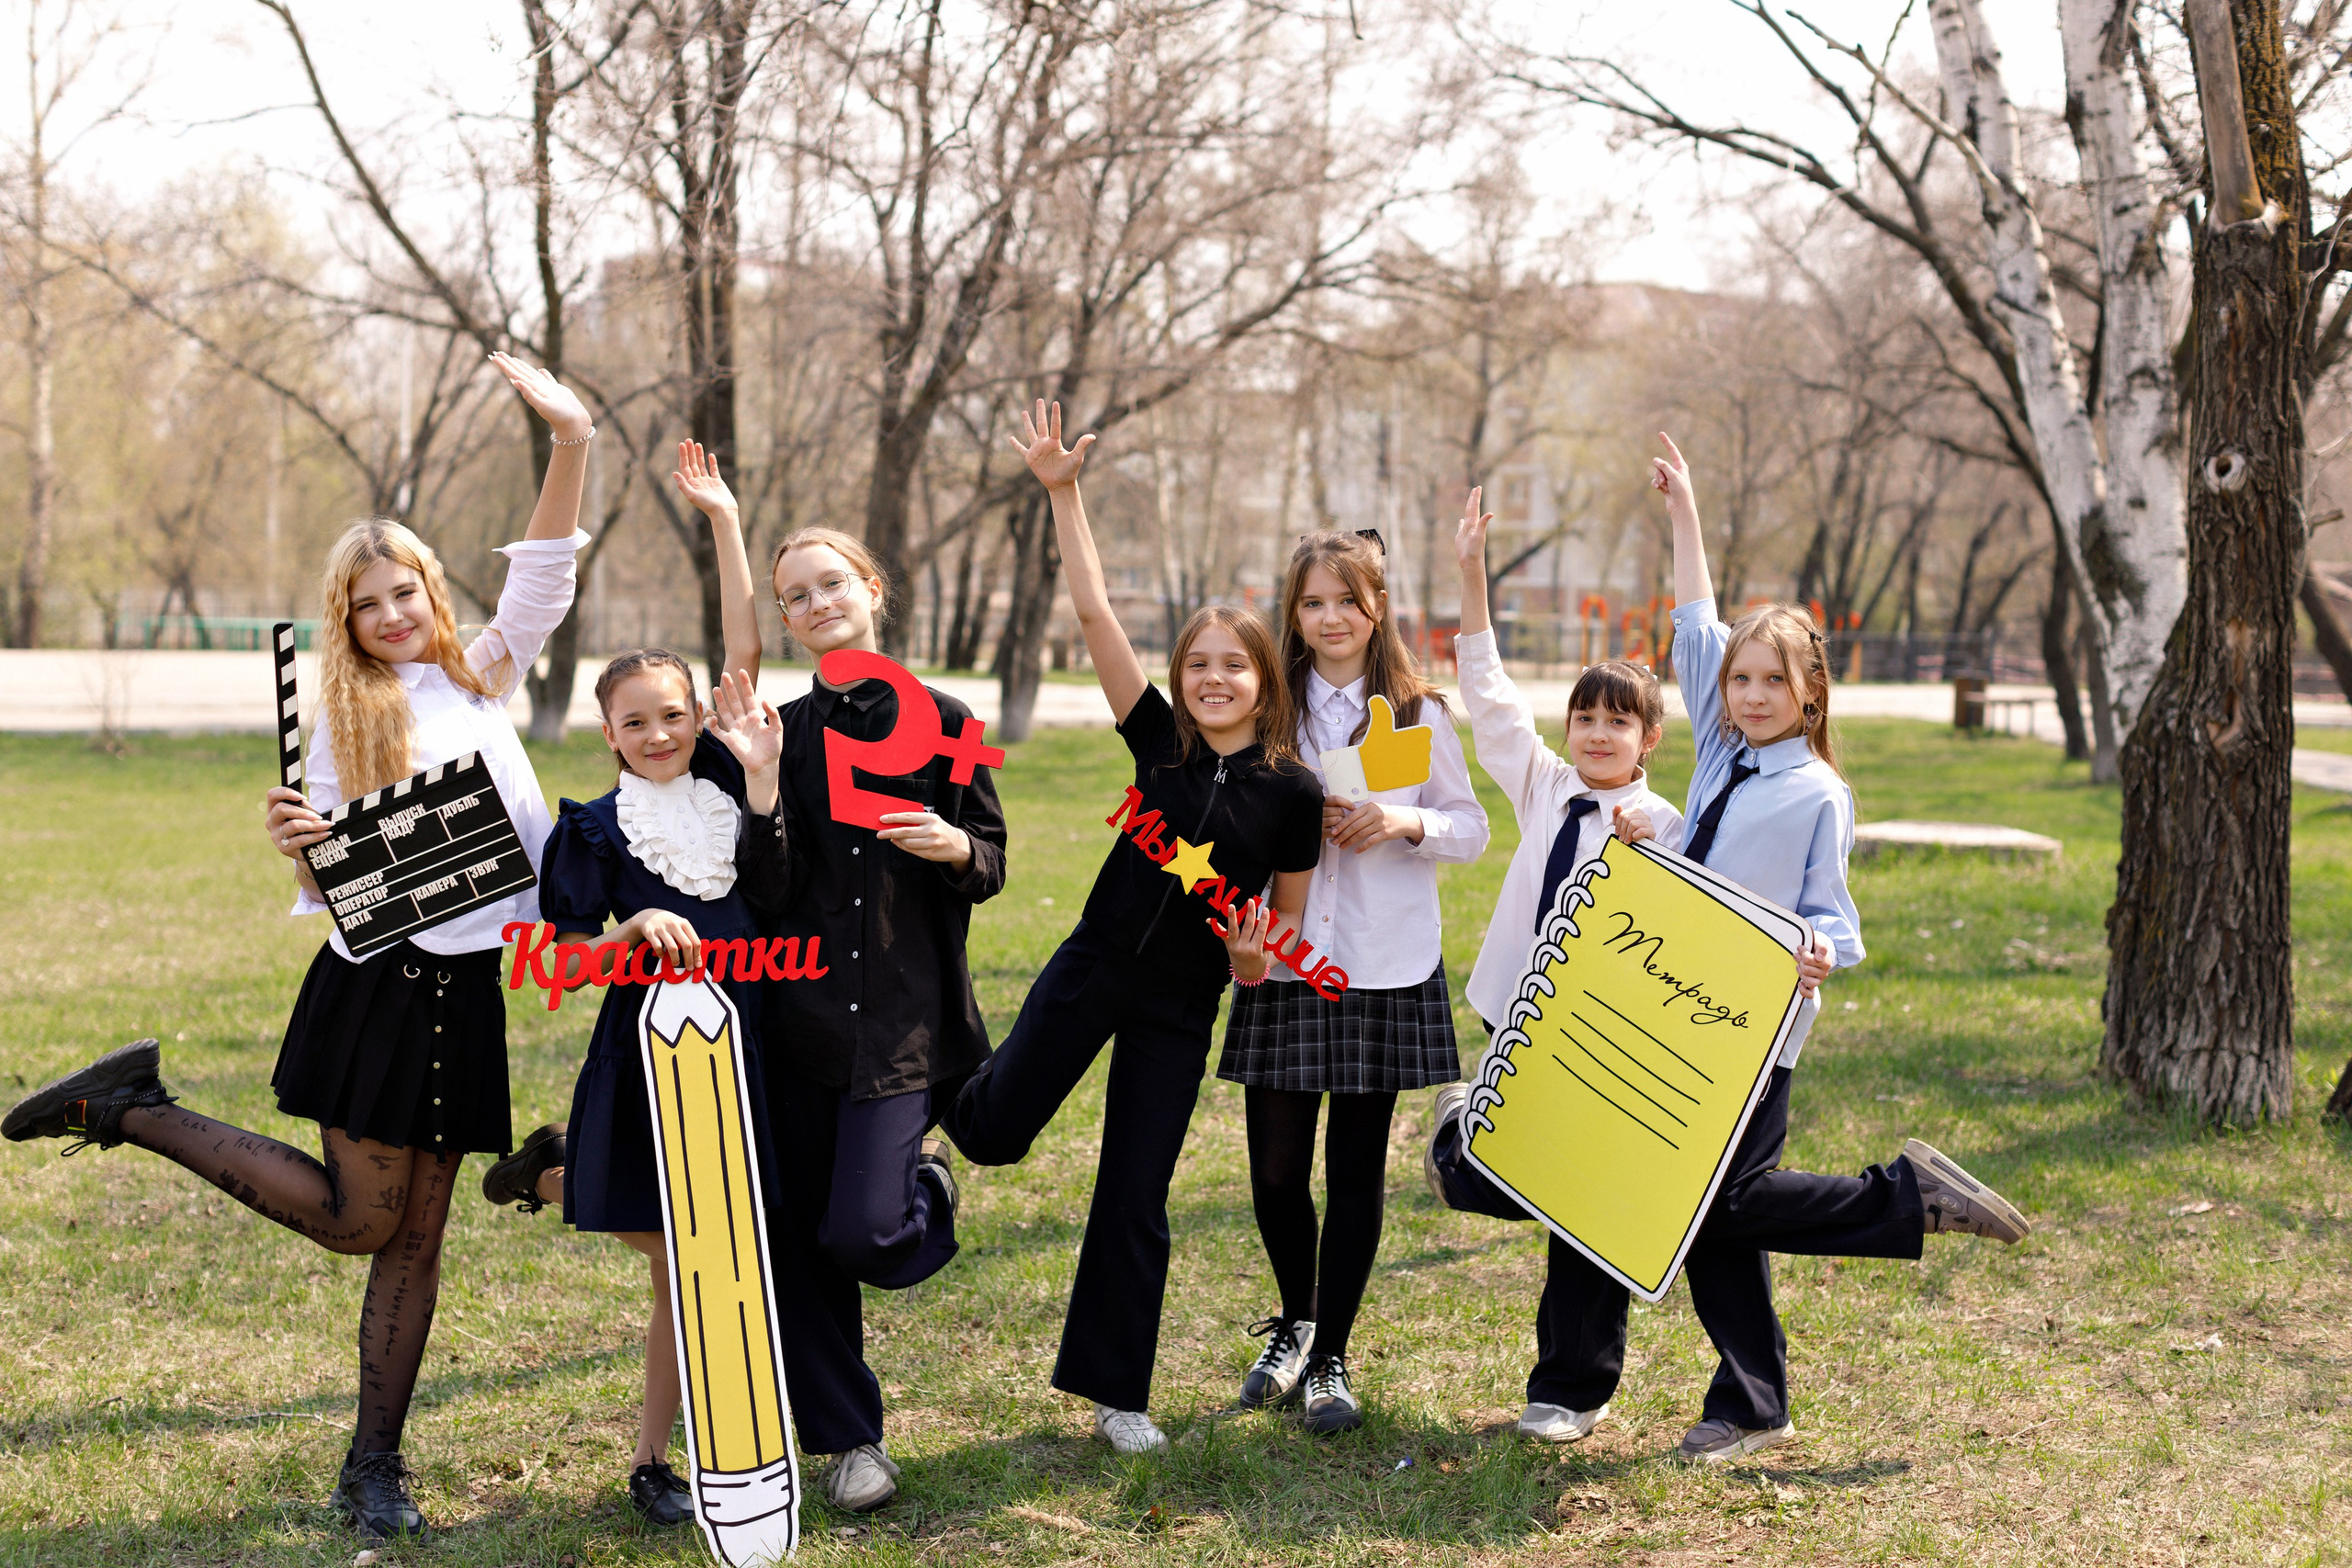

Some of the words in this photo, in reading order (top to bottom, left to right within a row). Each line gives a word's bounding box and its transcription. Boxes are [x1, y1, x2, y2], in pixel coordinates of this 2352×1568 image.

[821, 650, 1004, 830] 2+
[378, 803, 427, 831] ВЫПУСК
[440, 793, 480, 819] ДУБЛЬ
[385, 818, 415, 840] КАДР
[308, 834, 352, 859] ФИЛЬМ
[311, 847, 349, 869] СЦЕНА
[469, 858, 499, 878] ЗВУК
[326, 872, 383, 902] РЕЖИССЕР
[413, 874, 458, 901] КАМЕРА
[1106, 785, 1177, 865] Мы
[1193, 875, 1349, 1001] лушие
[333, 886, 388, 916] ОПЕРАТОР
[342, 911, 372, 931] ДАТА
[1602, 911, 1748, 1029] Тетрадь
